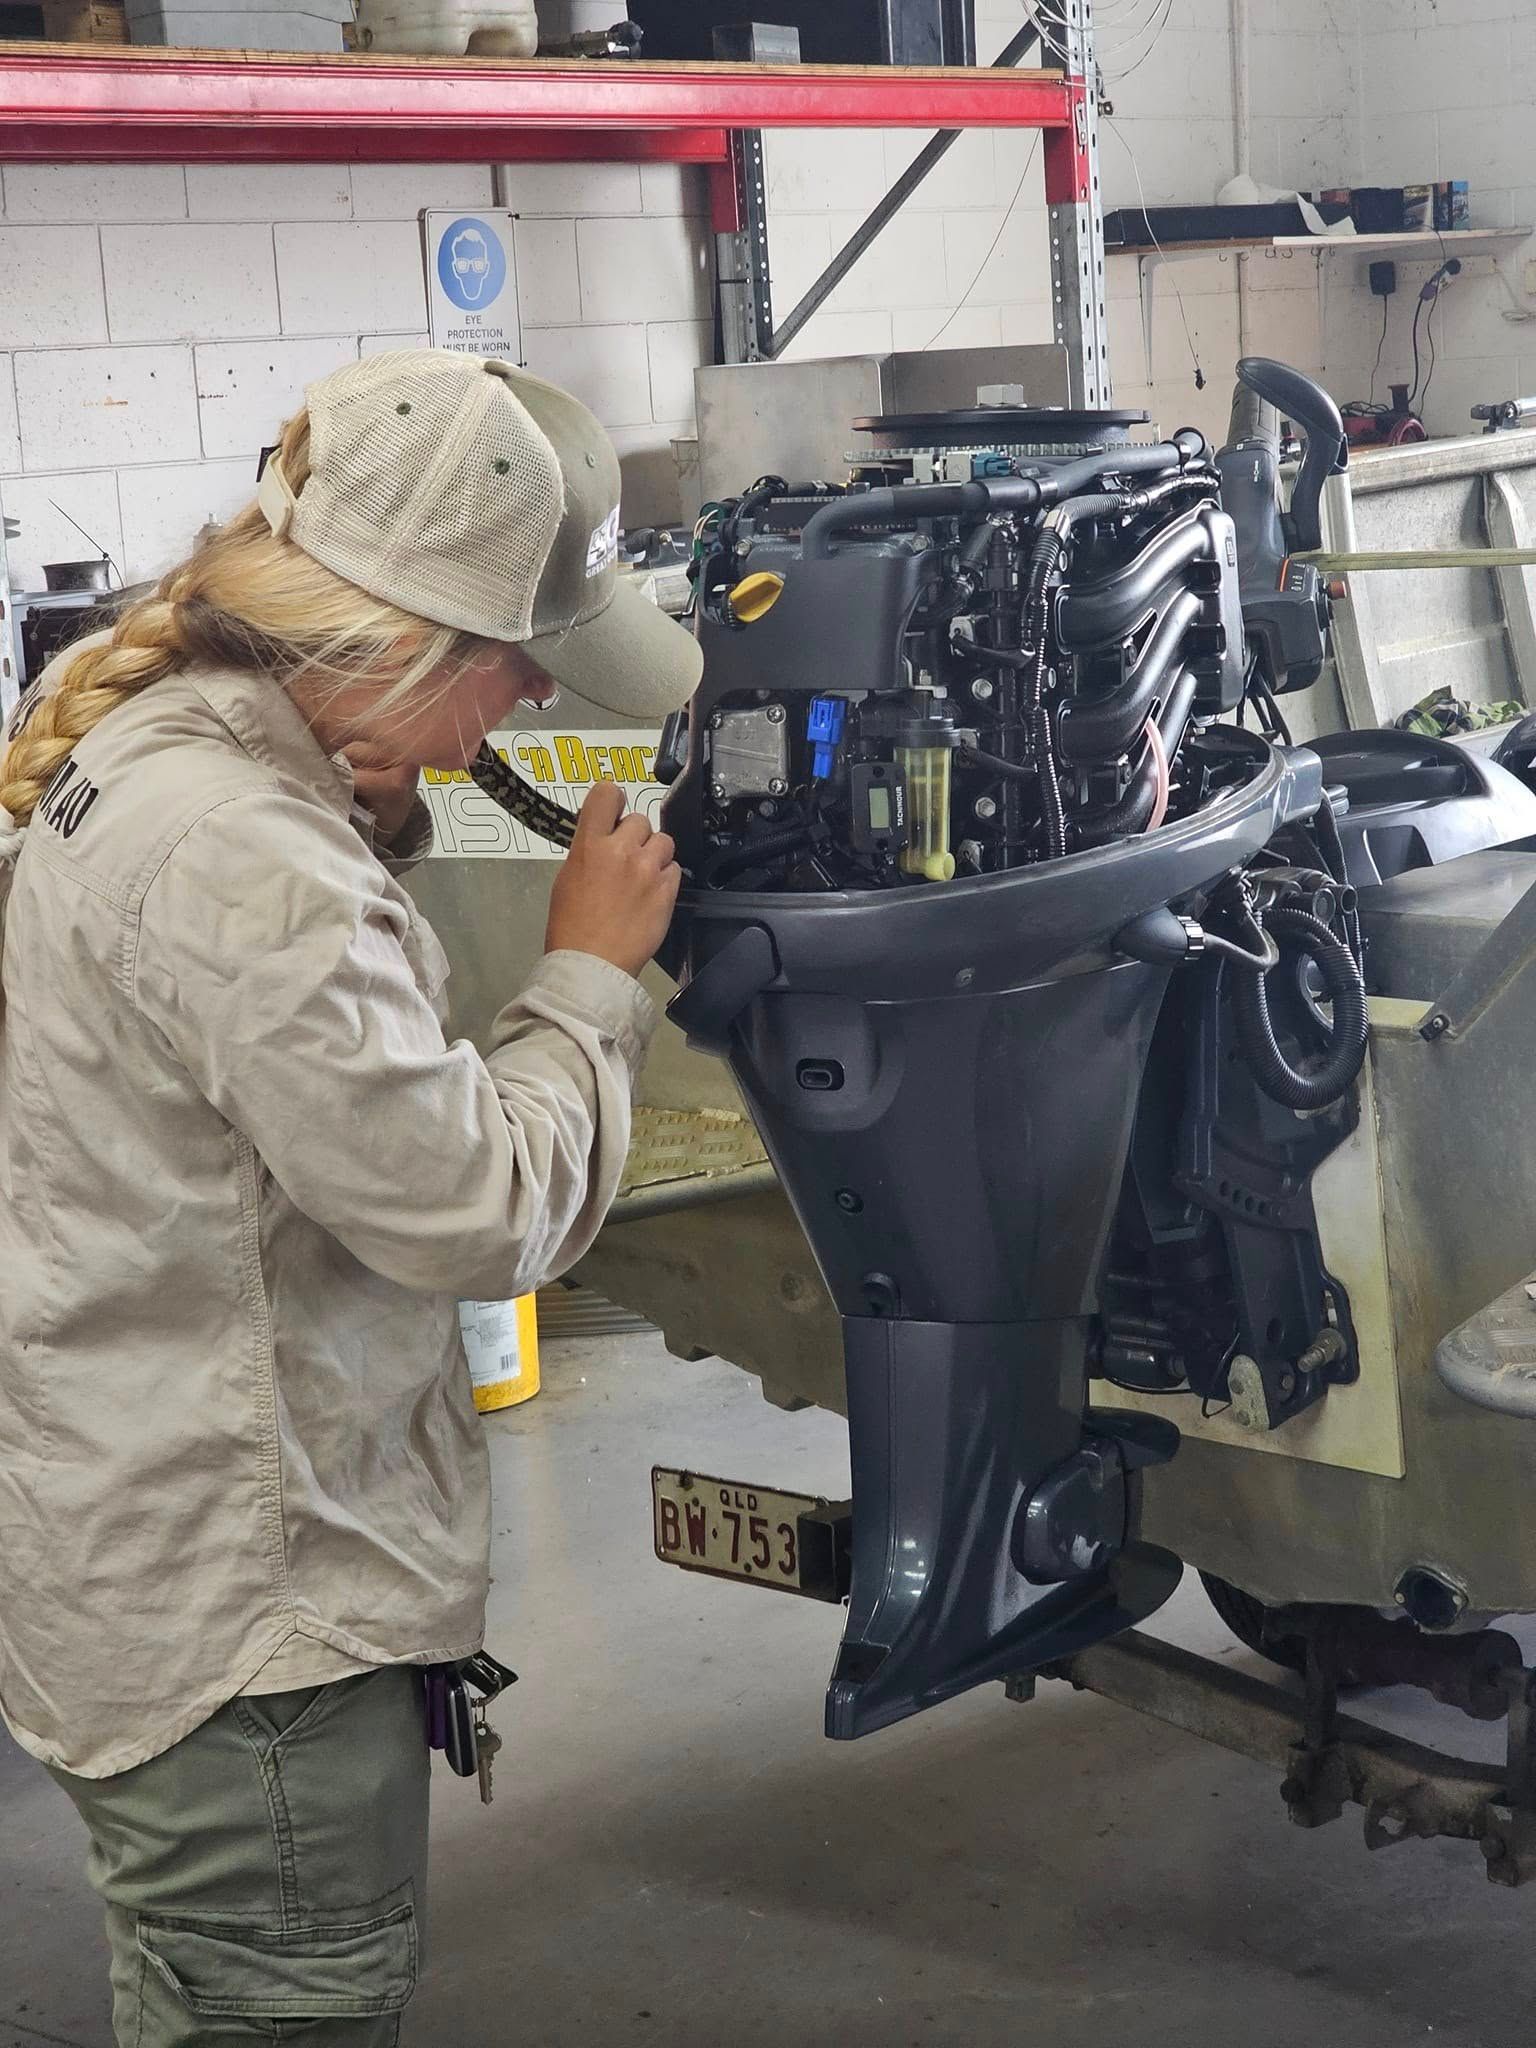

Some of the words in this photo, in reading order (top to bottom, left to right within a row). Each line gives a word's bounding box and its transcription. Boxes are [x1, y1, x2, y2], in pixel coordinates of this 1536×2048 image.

[465, 315, 482, 325] EYE
[447, 328, 503, 339] PROTECTION
[468, 343, 479, 352] BE
[482, 342, 511, 351] WORN
[553, 735, 660, 783] BEAC
[720, 1489, 757, 1511] QLD
